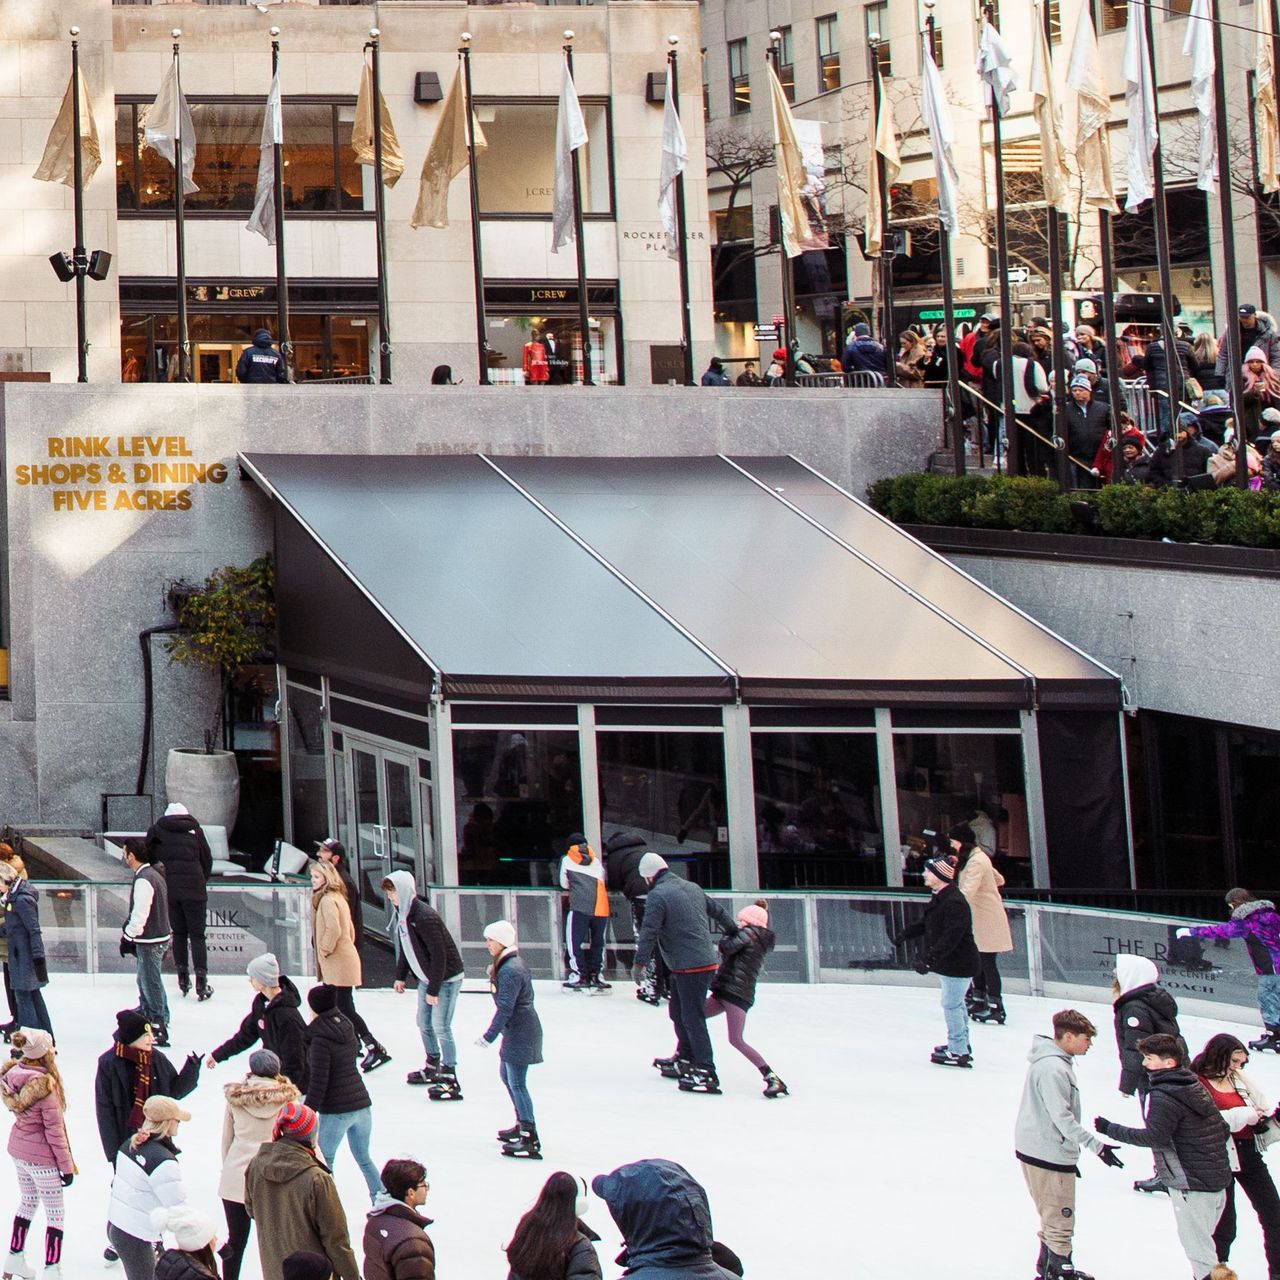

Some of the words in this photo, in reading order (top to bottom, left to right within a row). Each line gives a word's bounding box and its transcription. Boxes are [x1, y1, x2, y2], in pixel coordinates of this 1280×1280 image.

[526, 187, 554, 198] J.CRE
[531, 290, 567, 301] J.CREW
[48, 437, 112, 457] RINK
[118, 437, 192, 457] LEVEL
[16, 464, 102, 485] SHOPS
[107, 463, 128, 484] &
[134, 463, 228, 484] DINING
[53, 490, 108, 511] FIVE
[113, 490, 193, 511] ACRES
[210, 910, 239, 927] INK
